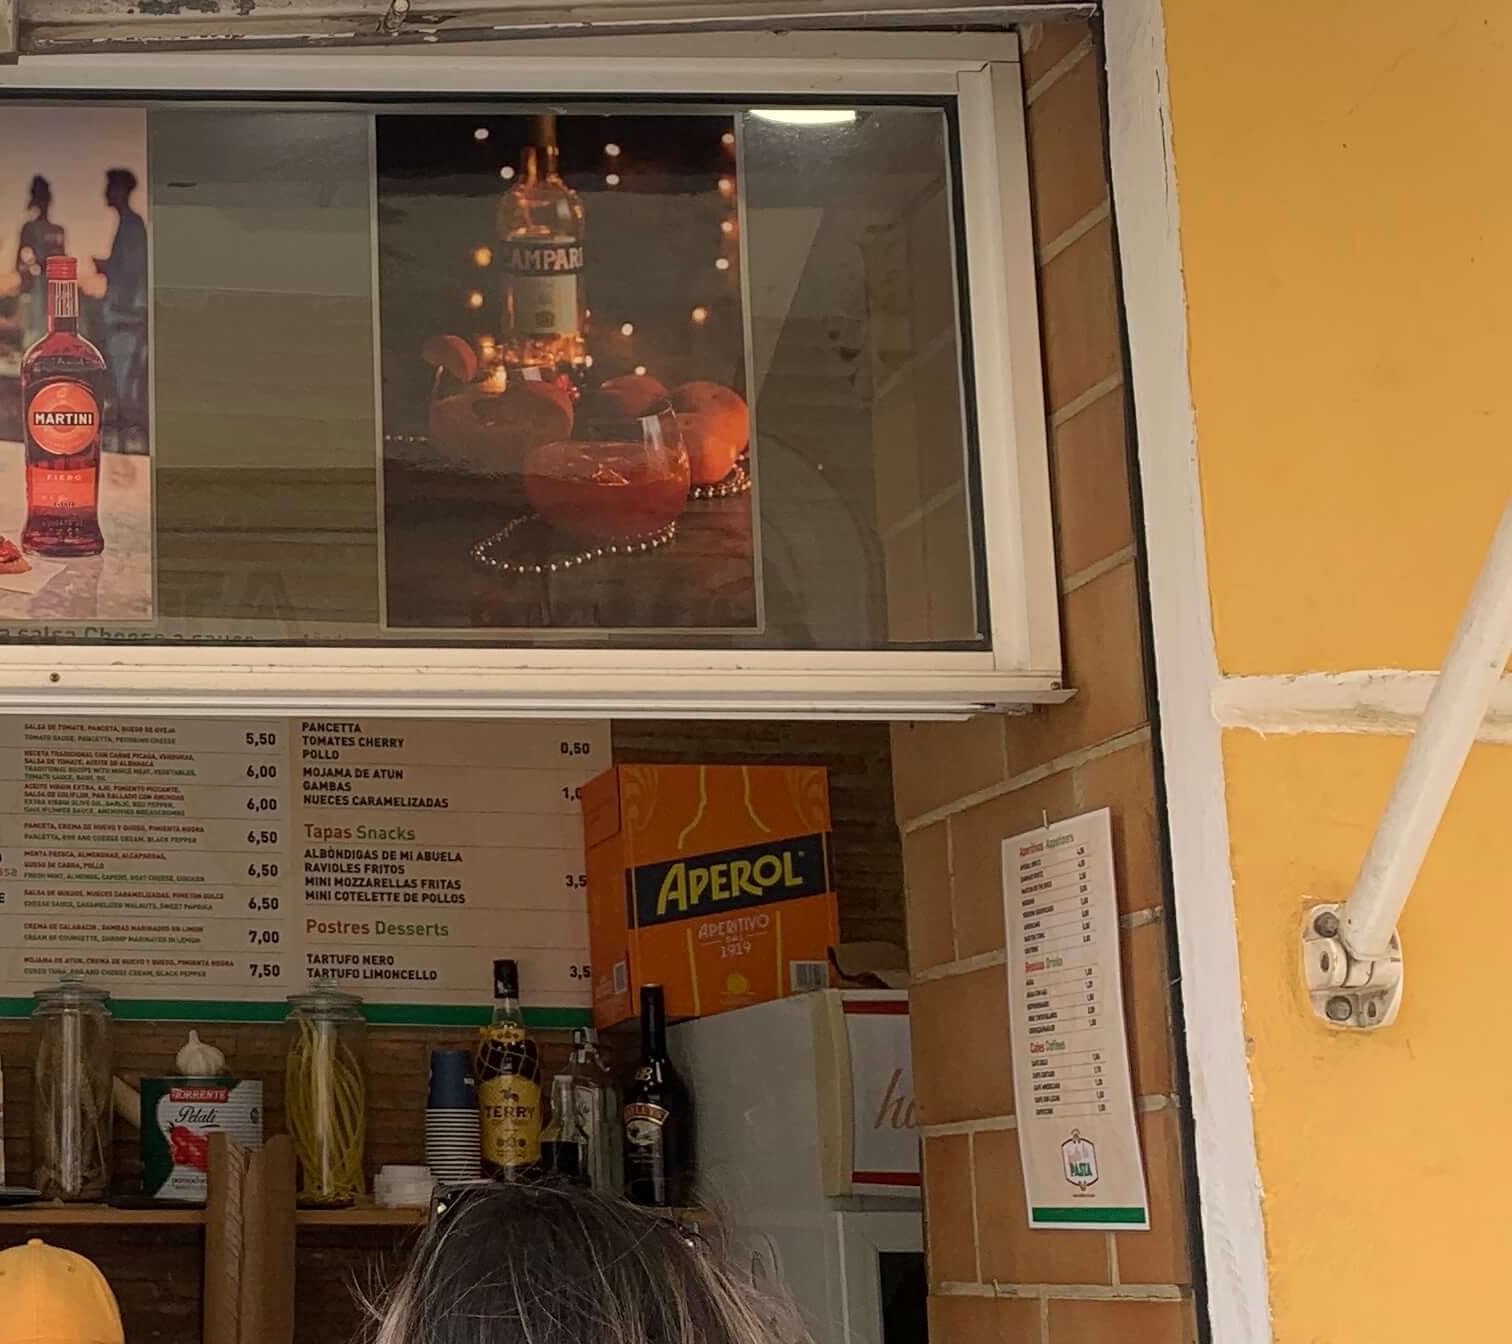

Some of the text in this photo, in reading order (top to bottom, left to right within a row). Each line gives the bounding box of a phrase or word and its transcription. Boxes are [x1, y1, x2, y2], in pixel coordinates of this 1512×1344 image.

[502, 244, 584, 273] AMPARI
[35, 413, 93, 425] MARTINI
[301, 722, 362, 733] PANCETTA
[246, 732, 276, 746] 5,50
[302, 736, 404, 748] TOMATES CHERRY
[302, 749, 339, 760] POLLO
[560, 742, 590, 756] 0,50
[246, 765, 277, 779] 6,00
[303, 767, 403, 780] MOJAMA DE ATUN
[303, 781, 352, 792] GAMBAS
[303, 794, 449, 808] NUECES CARAMELIZADAS
[562, 787, 583, 801] 1,0
[246, 798, 277, 812] 6,00
[247, 830, 278, 845] 6,50
[304, 824, 415, 841] Tapas Snacks
[381, 850, 396, 861] DE
[399, 850, 414, 861] MI
[416, 851, 463, 862] ABUELA
[248, 863, 278, 878] 6,50
[304, 862, 405, 874] RAVIOLES FRITOS
[305, 876, 461, 890] MINI MOZZARELLAS FRITAS
[565, 875, 587, 888] 3,5
[656, 851, 804, 916] APEROL
[248, 896, 279, 911] 6,50
[305, 890, 466, 904] MINI COTELETTE DE POLLOS
[306, 919, 449, 936] Postres Desserts
[698, 914, 769, 939] APERITIVO
[248, 930, 280, 945] 7,00
[306, 953, 394, 965] TARTUFO NERO
[249, 963, 280, 978] 7,50
[307, 967, 437, 980] TARTUFO LIMONCELLO
[569, 965, 591, 979] 3,5
[485, 1105, 536, 1119] TERRY
